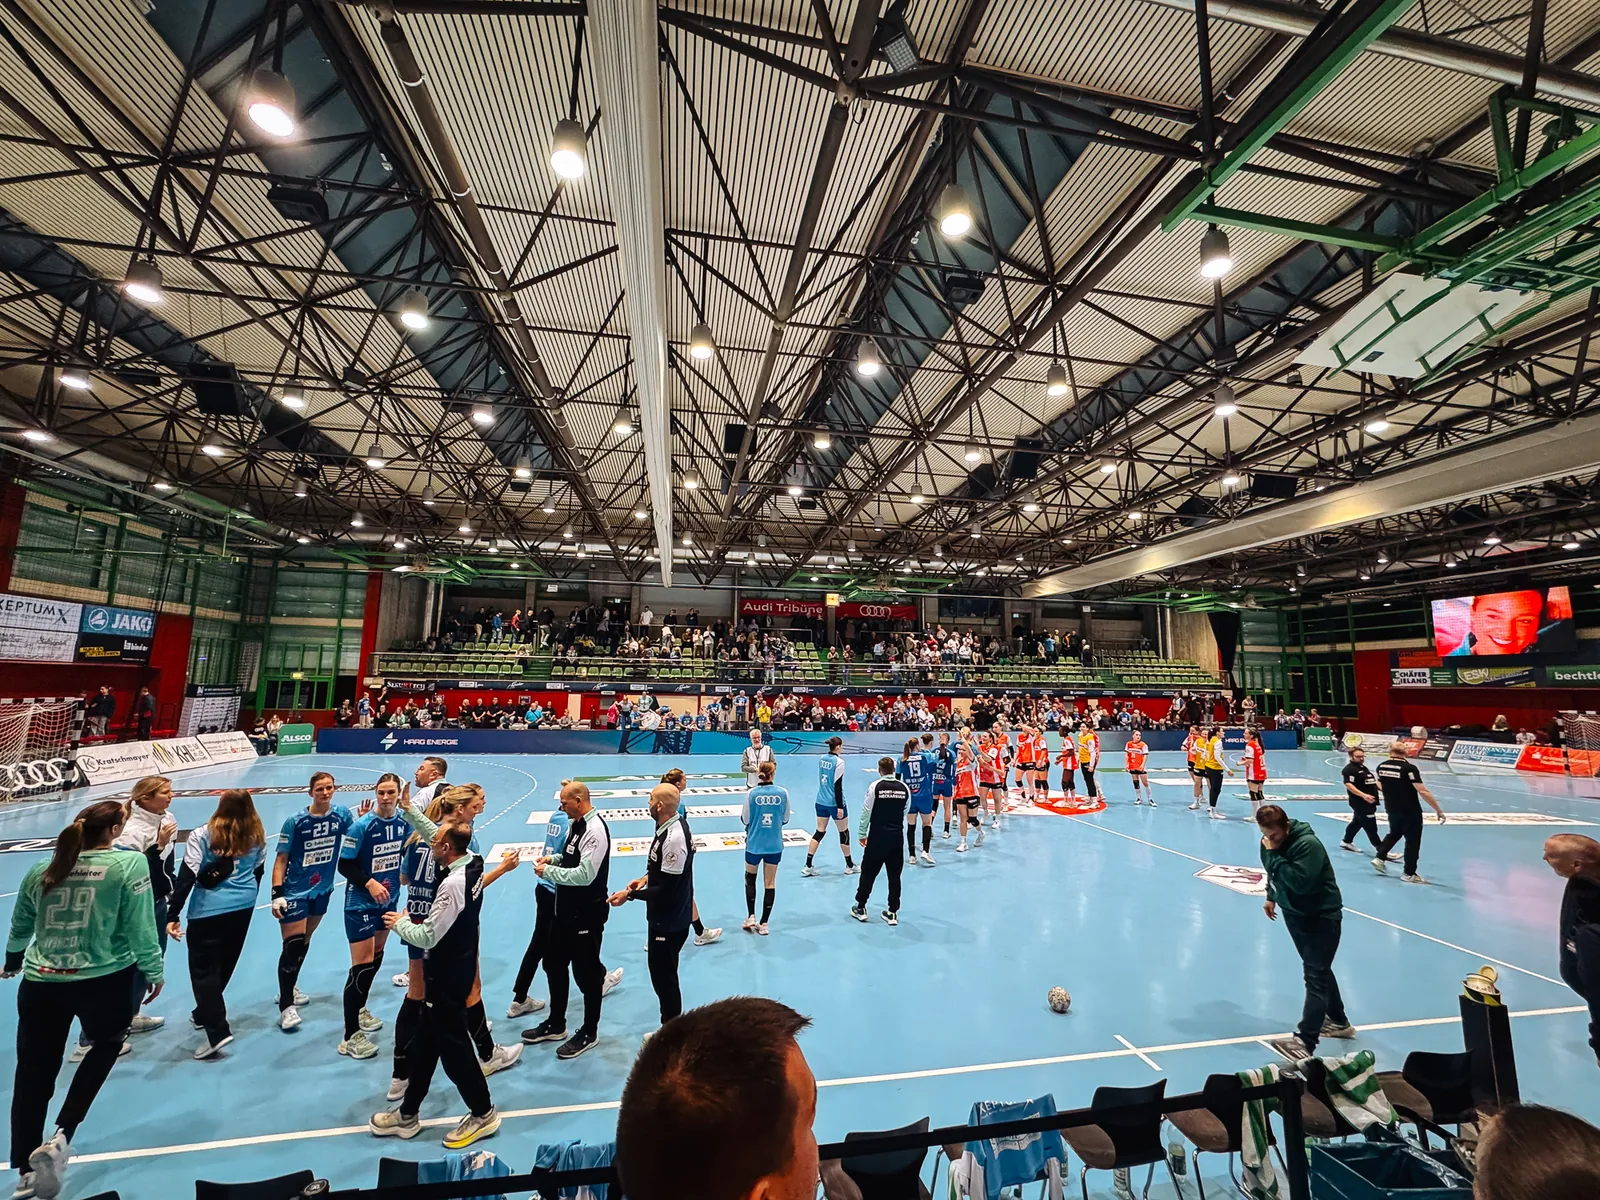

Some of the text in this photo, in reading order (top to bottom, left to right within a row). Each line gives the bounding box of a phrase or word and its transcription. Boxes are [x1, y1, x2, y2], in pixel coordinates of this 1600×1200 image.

[743, 602, 823, 614] Audi Tribüne
[111, 613, 152, 632] JAKO
[1395, 669, 1427, 678] SCHÄFER
[1463, 668, 1489, 681] ESK
[1393, 677, 1428, 685] WIELAND
[281, 734, 311, 742] ALSCO
[1457, 743, 1519, 754] HEILBRONNER
[96, 754, 149, 766] Kratschmayer
[908, 762, 921, 777] 19
[313, 821, 329, 838] 23
[385, 825, 394, 840] 11
[45, 887, 96, 929] 29
